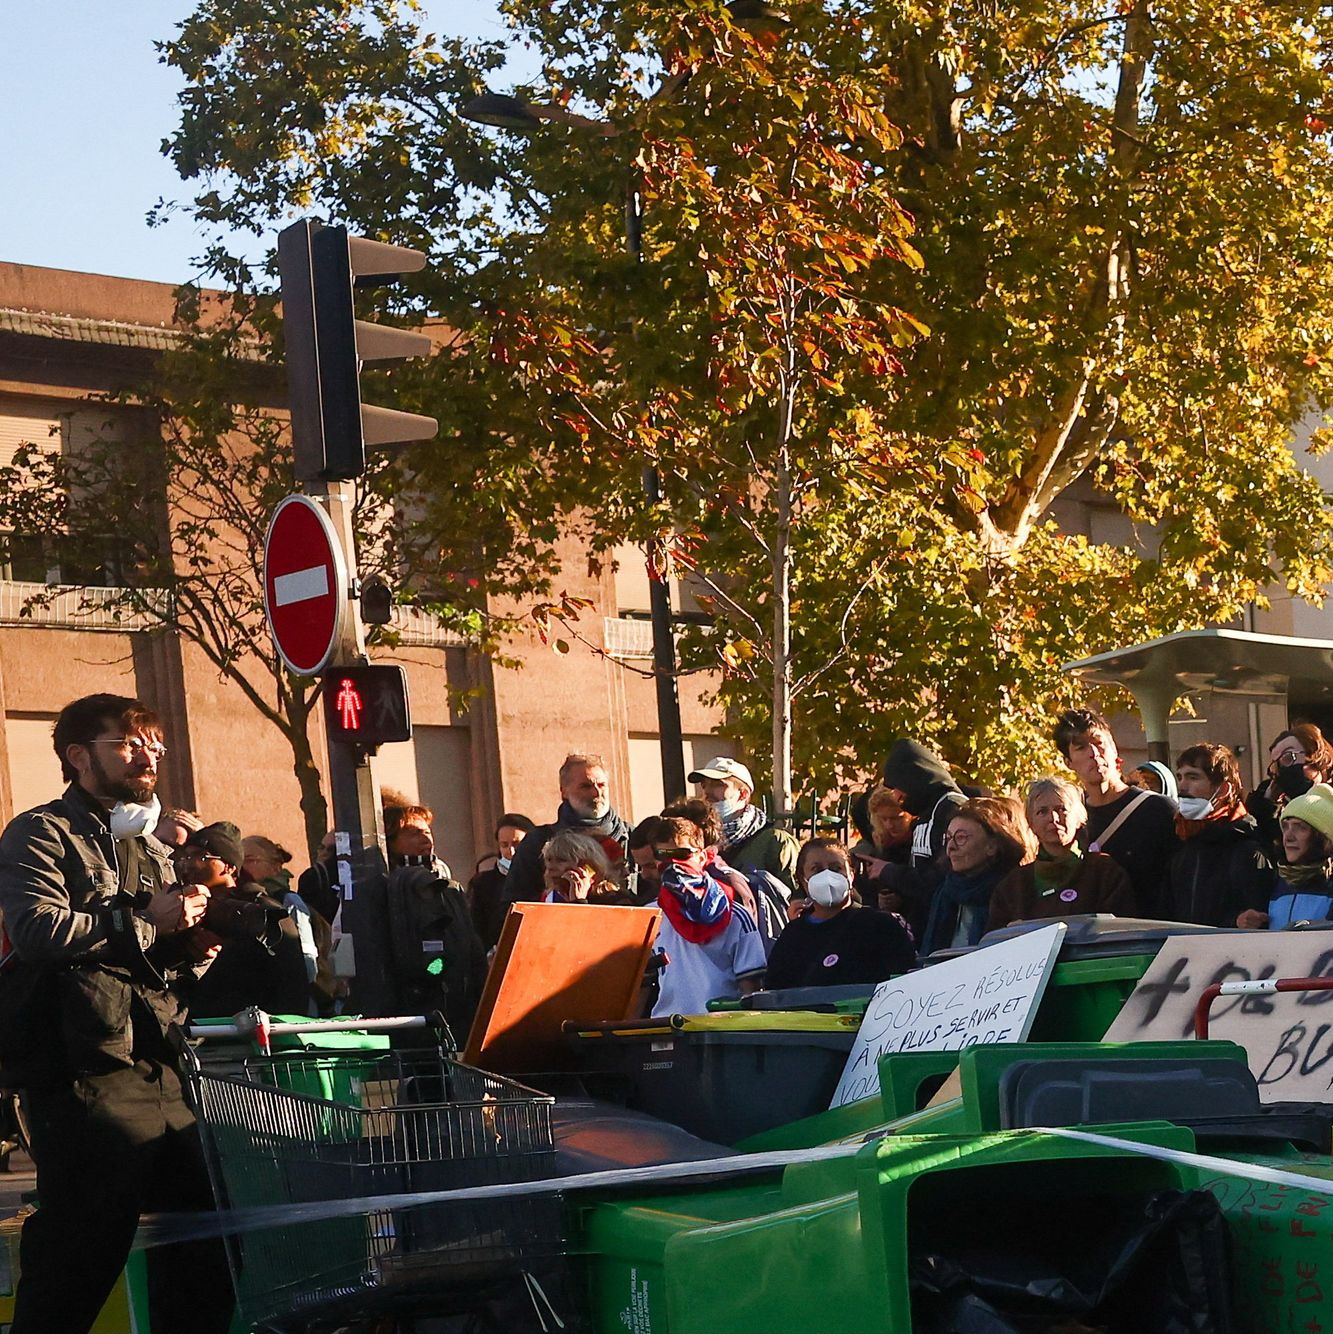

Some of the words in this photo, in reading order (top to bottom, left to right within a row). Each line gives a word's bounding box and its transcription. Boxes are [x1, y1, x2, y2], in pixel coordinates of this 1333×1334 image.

[973, 957, 1047, 1000] RÉSOLUS
[900, 1024, 942, 1050] PLUS
[943, 1003, 1000, 1038] SERVIR
[1002, 995, 1027, 1014] ET
[1295, 1261, 1323, 1303] DE
